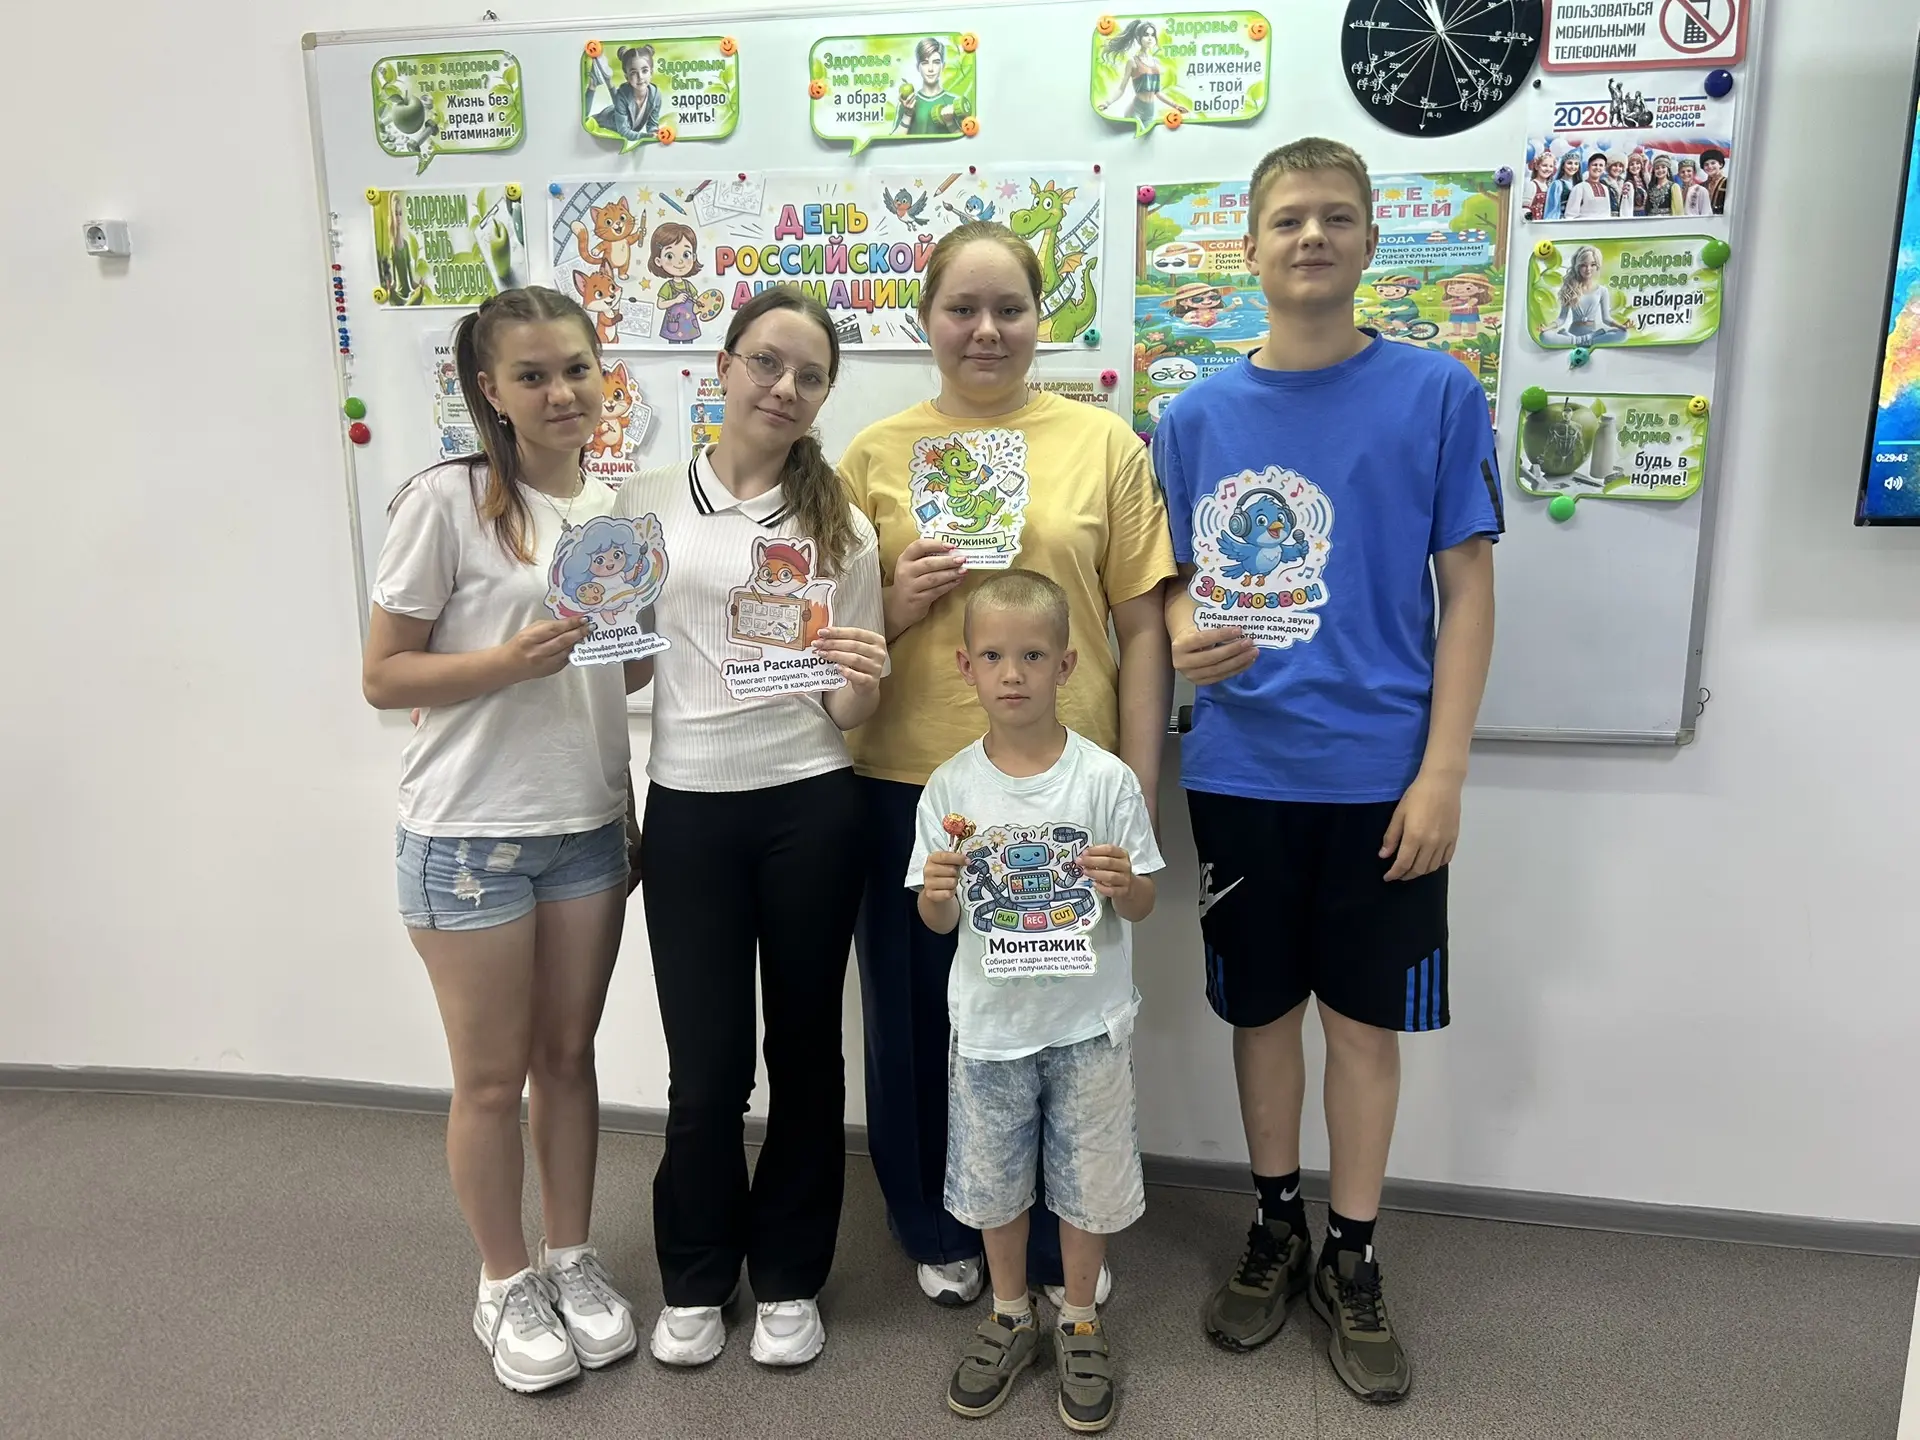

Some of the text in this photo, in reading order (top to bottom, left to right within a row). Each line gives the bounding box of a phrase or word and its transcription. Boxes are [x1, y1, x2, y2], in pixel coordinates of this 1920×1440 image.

[1557, 1, 1653, 19] ПОЛЬЗОВАТЬСЯ
[1166, 18, 1238, 39] Здоровье
[1556, 23, 1645, 39] МОБИЛЬНЫМИ
[1163, 41, 1249, 58] твой стиль,
[1554, 44, 1636, 60] ТЕЛЕФОНАМИ
[397, 61, 417, 76] Мы
[421, 63, 436, 75] за
[440, 60, 499, 77] здоровье
[657, 58, 725, 77] Здоровым
[824, 52, 891, 72] Здоровье
[1187, 61, 1261, 76] движение
[418, 74, 488, 92] ты с нами?
[672, 74, 703, 90] быть
[833, 72, 894, 87] не мода,
[1209, 77, 1243, 93] твой
[447, 92, 508, 108] Жизнь без
[671, 94, 726, 110] здорово
[834, 89, 886, 108] а образ
[1194, 95, 1244, 114] выбор!
[1658, 97, 1676, 105] ГОД
[679, 108, 715, 123] жить!
[836, 107, 884, 122] жизни!
[1553, 105, 1608, 127] 2026
[1656, 112, 1701, 121] НАРОДОВ
[1657, 104, 1706, 113] ЕДИНСТВА
[449, 111, 505, 128] вреда и с
[1655, 120, 1694, 128] РОССИИ
[440, 124, 515, 140] витаминами!
[406, 194, 468, 231] ЗДОРОВЫМ
[774, 202, 869, 241] ДЕНЬ
[423, 230, 454, 263] БЫТЬ
[715, 233, 937, 276] РОССИЙСКОЙ
[1425, 244, 1484, 253] взрослыми!
[1620, 250, 1693, 272] Выбирай
[433, 263, 489, 301] ЗДОРОВО!
[1609, 273, 1688, 291] здоровье
[1633, 290, 1704, 310] выбирай
[1637, 308, 1690, 330] успех!
[1043, 381, 1094, 392] КАРТИНКИ
[1625, 408, 1679, 429] Будь в
[1617, 426, 1671, 448] форме
[1635, 451, 1687, 471] будь в
[1876, 453, 1908, 463] 0:29:43
[1631, 471, 1687, 489] норме!
[1199, 611, 1315, 626] Добавляет голоса, звуки
[587, 625, 638, 642] Искорка
[1266, 626, 1309, 635] каждому
[726, 664, 760, 676] Лина
[730, 676, 766, 686] Помогает
[768, 673, 810, 683] придумать,
[735, 685, 782, 696] происходить
[790, 681, 820, 689] каждом
[821, 677, 845, 687] кадре.
[997, 913, 1015, 923] PLAY
[1026, 916, 1043, 924] REC
[1054, 909, 1071, 921] CUT
[989, 937, 1087, 954] Монтажик
[985, 957, 1018, 966] Собирает
[1020, 957, 1042, 965] кадры
[988, 963, 1092, 974] история получилась цельной.
